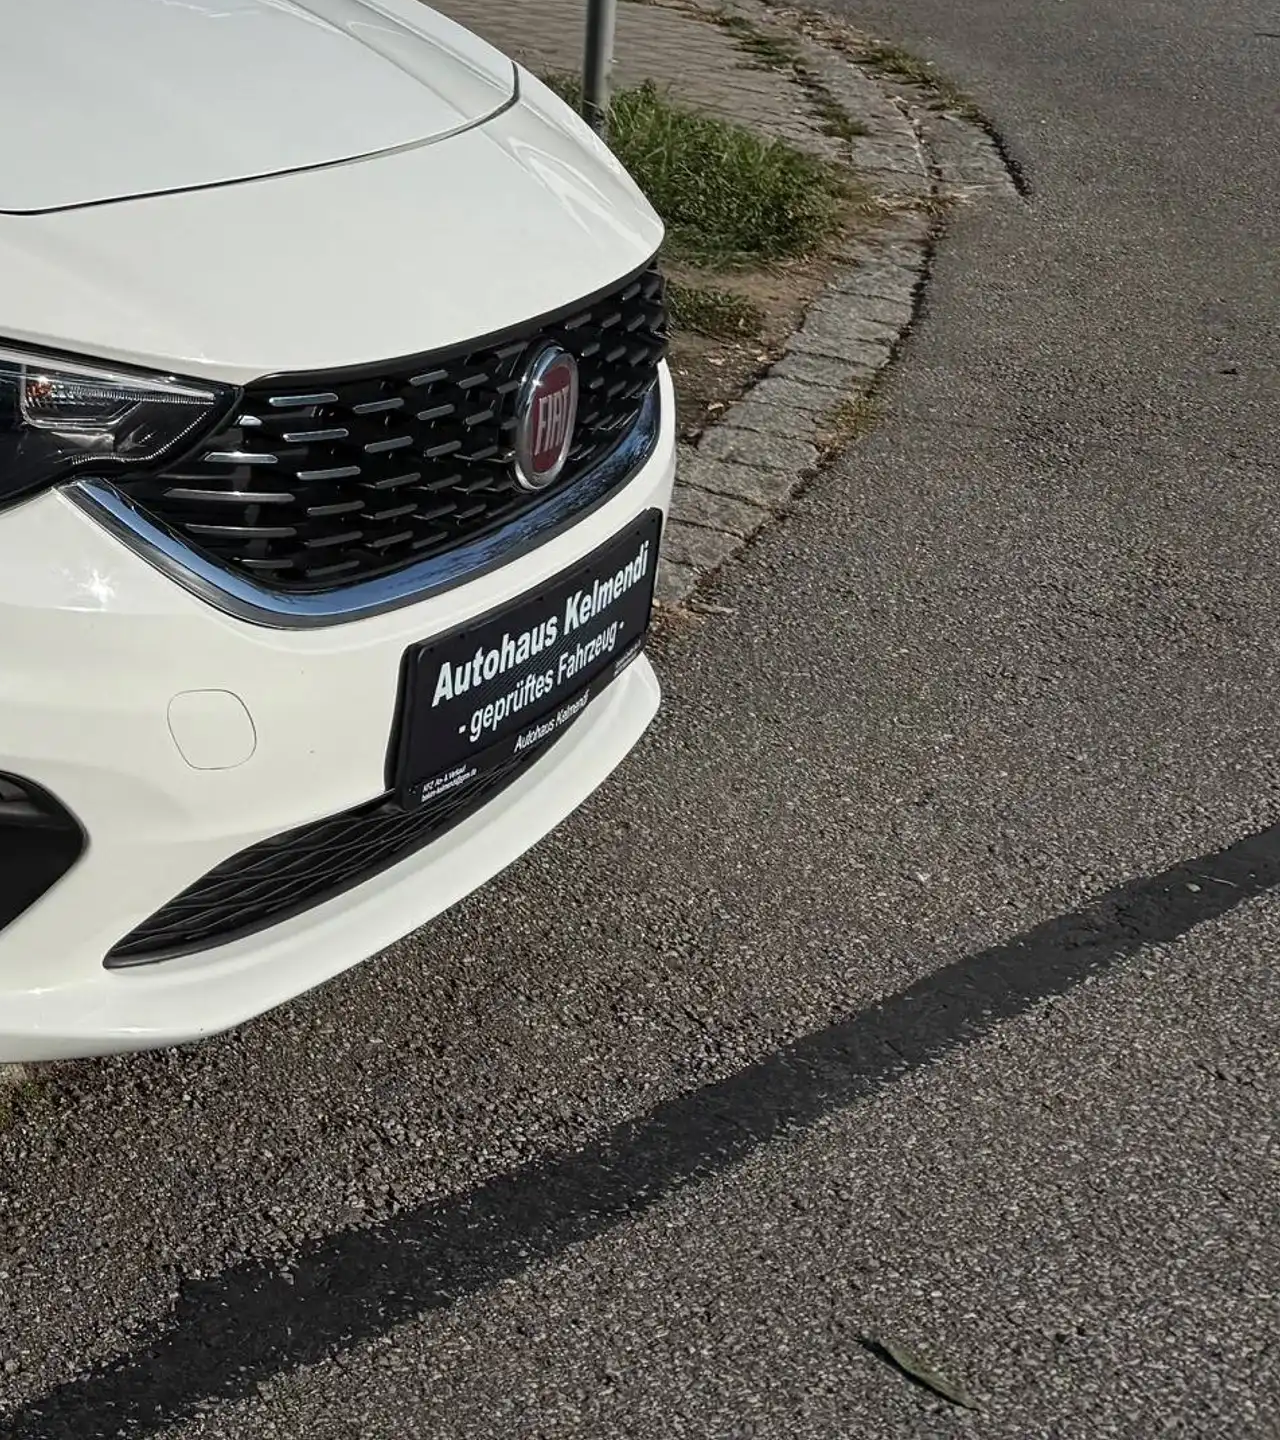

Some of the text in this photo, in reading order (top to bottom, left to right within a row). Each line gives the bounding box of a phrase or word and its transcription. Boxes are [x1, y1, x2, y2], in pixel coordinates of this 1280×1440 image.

[534, 384, 570, 456] FIAT
[431, 614, 558, 708] Autohaus
[563, 540, 651, 636] Kelmendi
[469, 669, 554, 743] geprüftes
[556, 621, 618, 685] Fahrzeug
[514, 717, 556, 753] Autohaus
